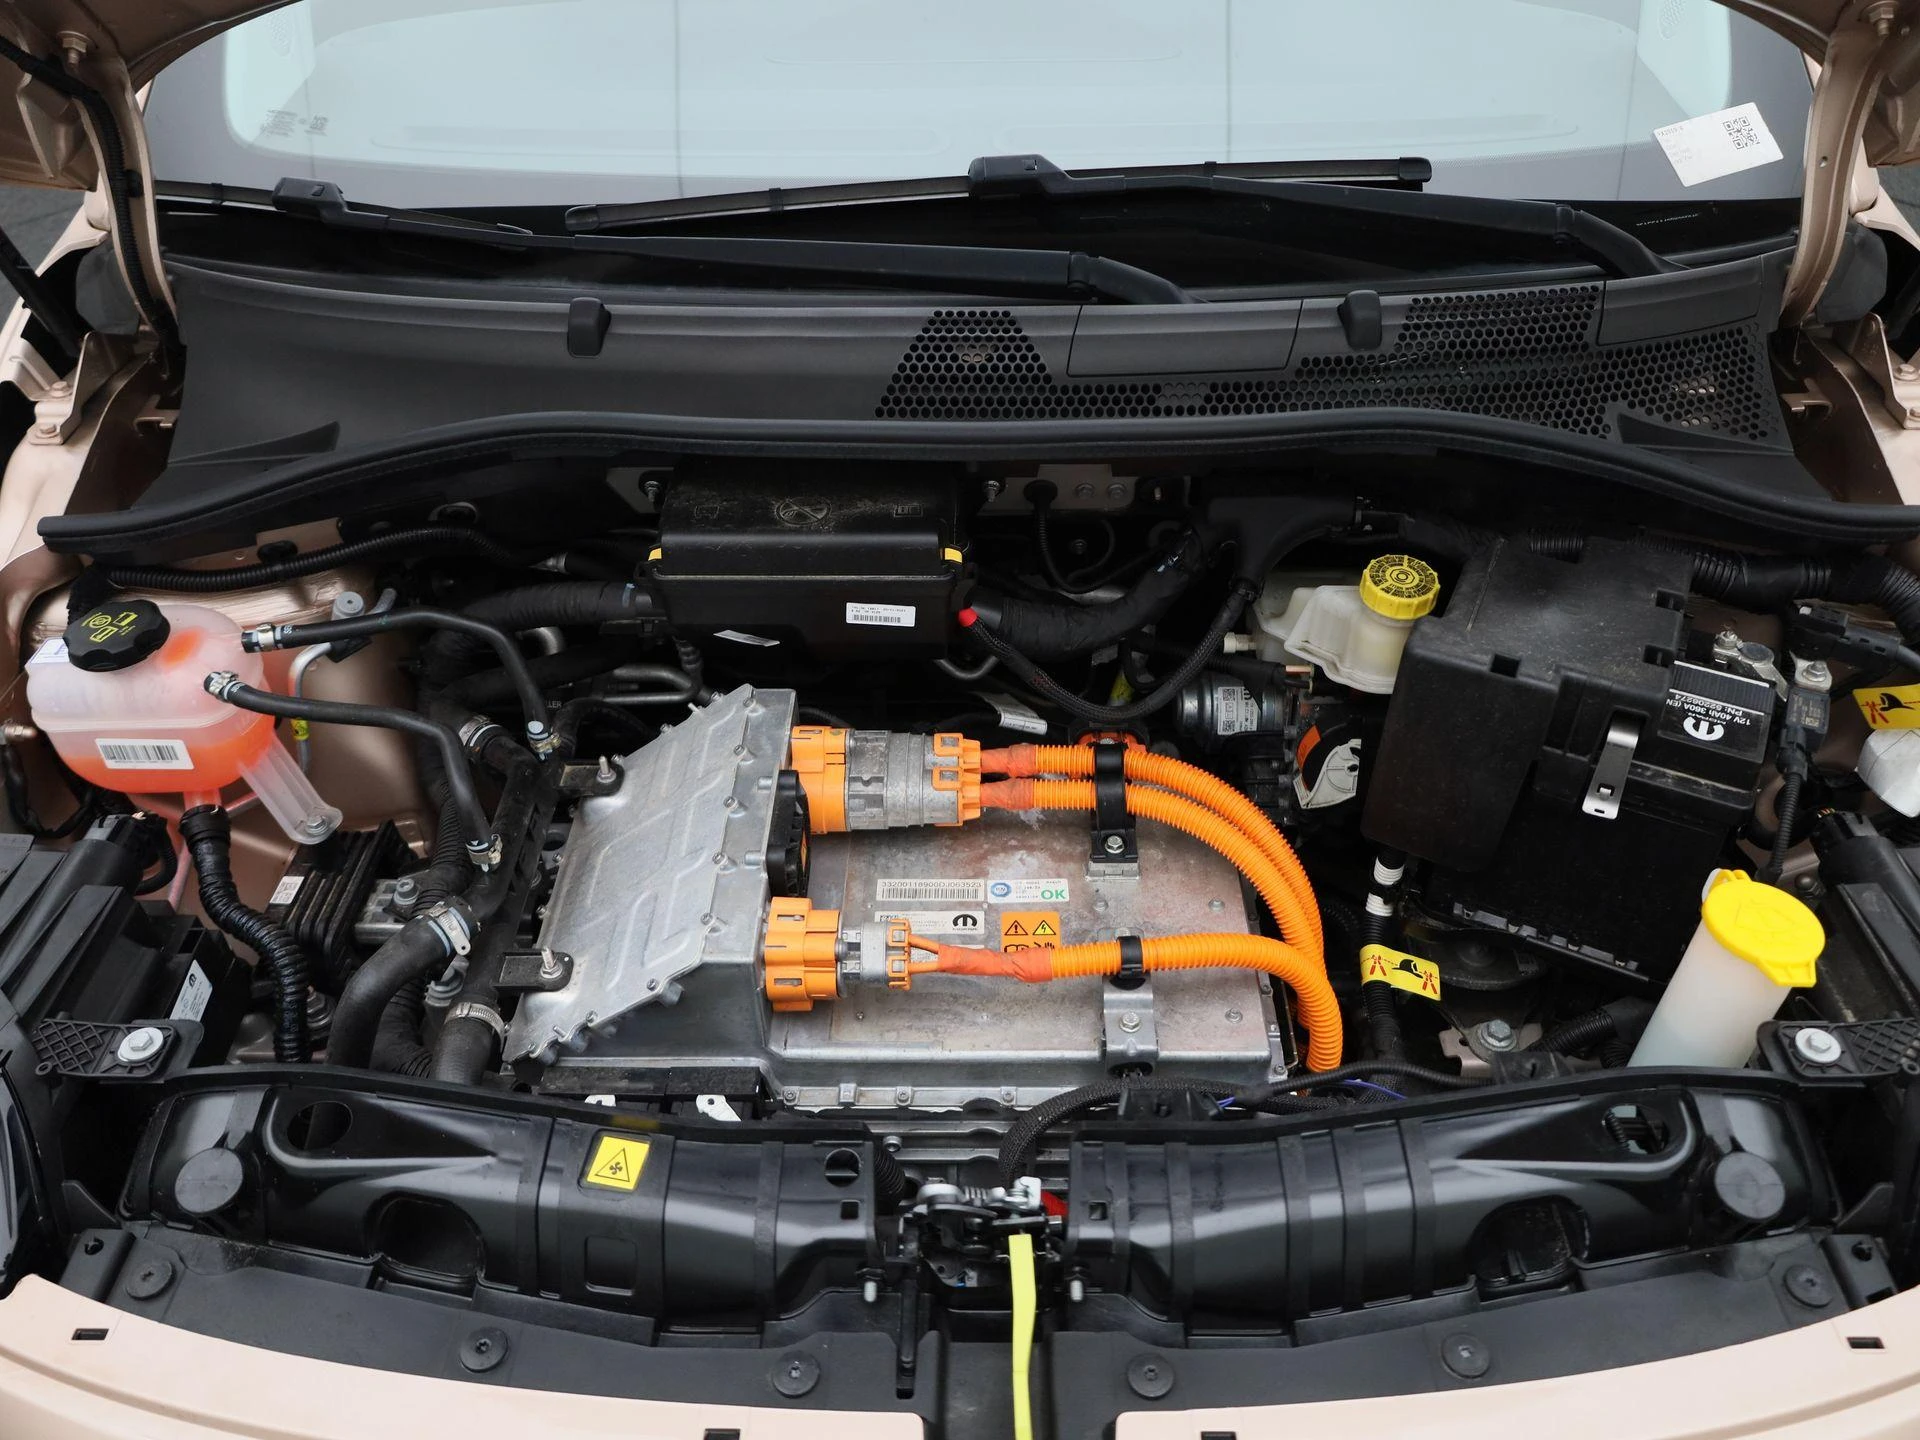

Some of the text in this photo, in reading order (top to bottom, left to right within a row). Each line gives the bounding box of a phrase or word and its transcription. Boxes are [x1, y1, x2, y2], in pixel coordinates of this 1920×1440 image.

[1683, 703, 1707, 715] 360A
[1708, 709, 1733, 721] 40Ah
[1724, 705, 1744, 717] PN:
[1733, 716, 1751, 726] 12V
[1040, 888, 1066, 900] OK
